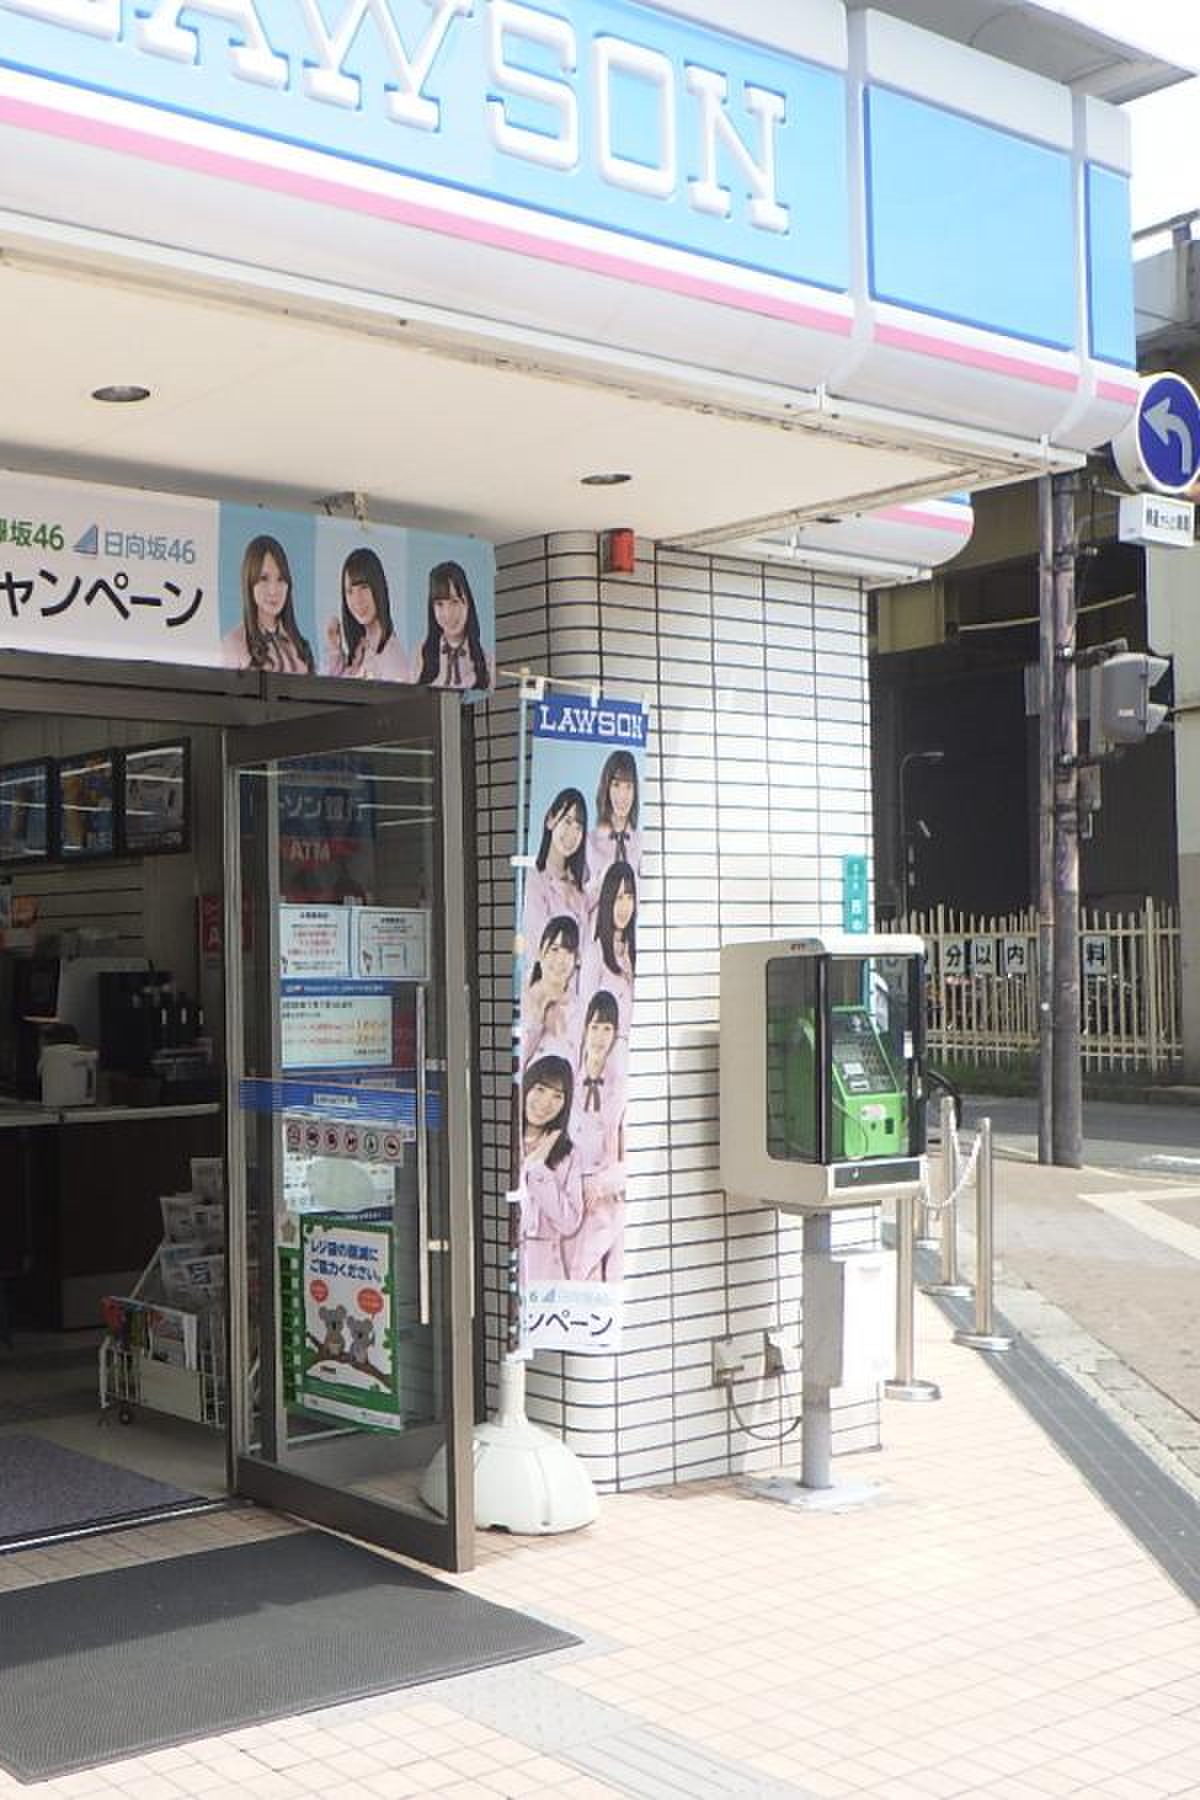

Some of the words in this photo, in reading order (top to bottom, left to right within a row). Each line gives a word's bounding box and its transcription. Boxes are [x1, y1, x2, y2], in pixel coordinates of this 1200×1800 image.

[0, 0, 792, 236] WSON
[103, 530, 197, 565] 日向坂46
[539, 704, 643, 740] LAWSON
